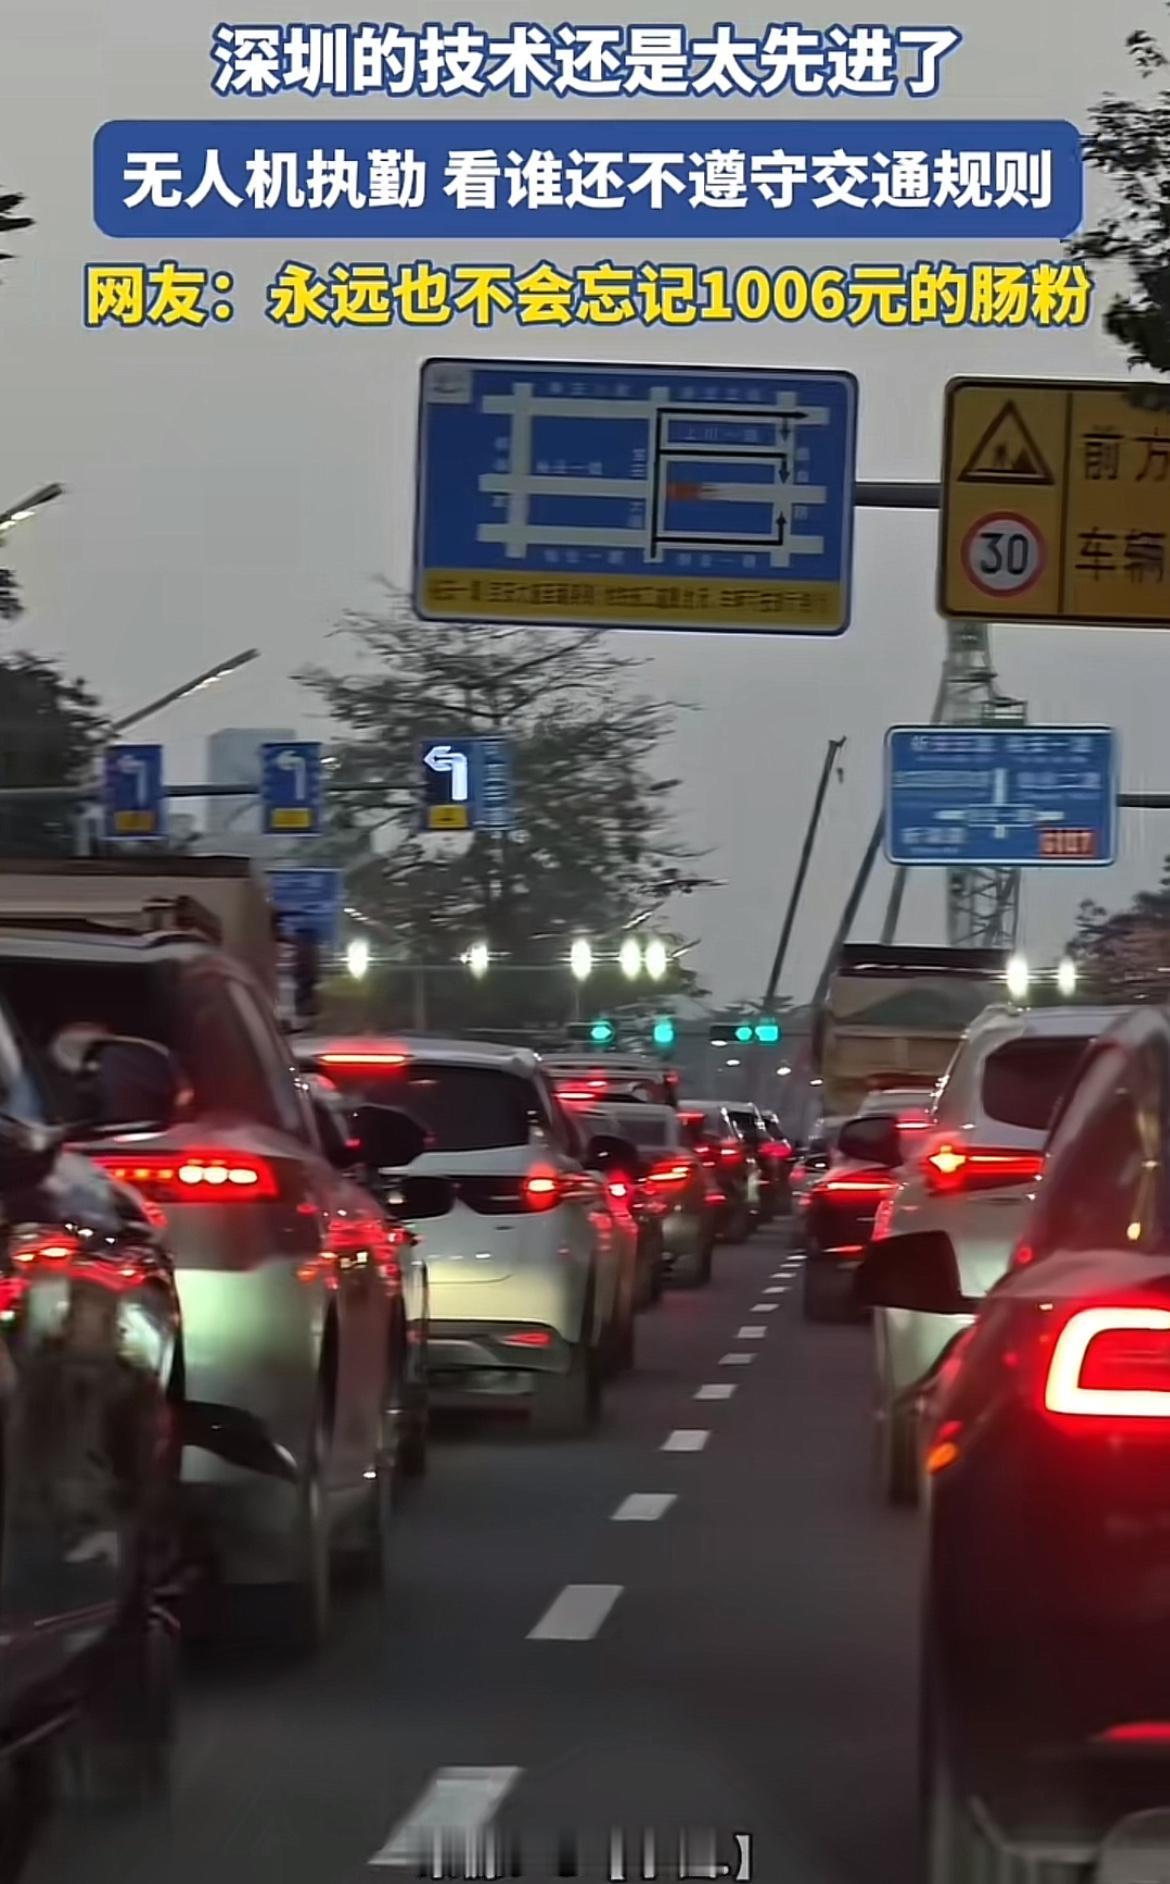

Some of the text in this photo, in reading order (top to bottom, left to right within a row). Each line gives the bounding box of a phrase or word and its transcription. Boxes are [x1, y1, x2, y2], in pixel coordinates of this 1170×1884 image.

[1083, 426, 1170, 481] 前方
[980, 532, 1030, 576] 30
[1075, 527, 1166, 583] 车辆
